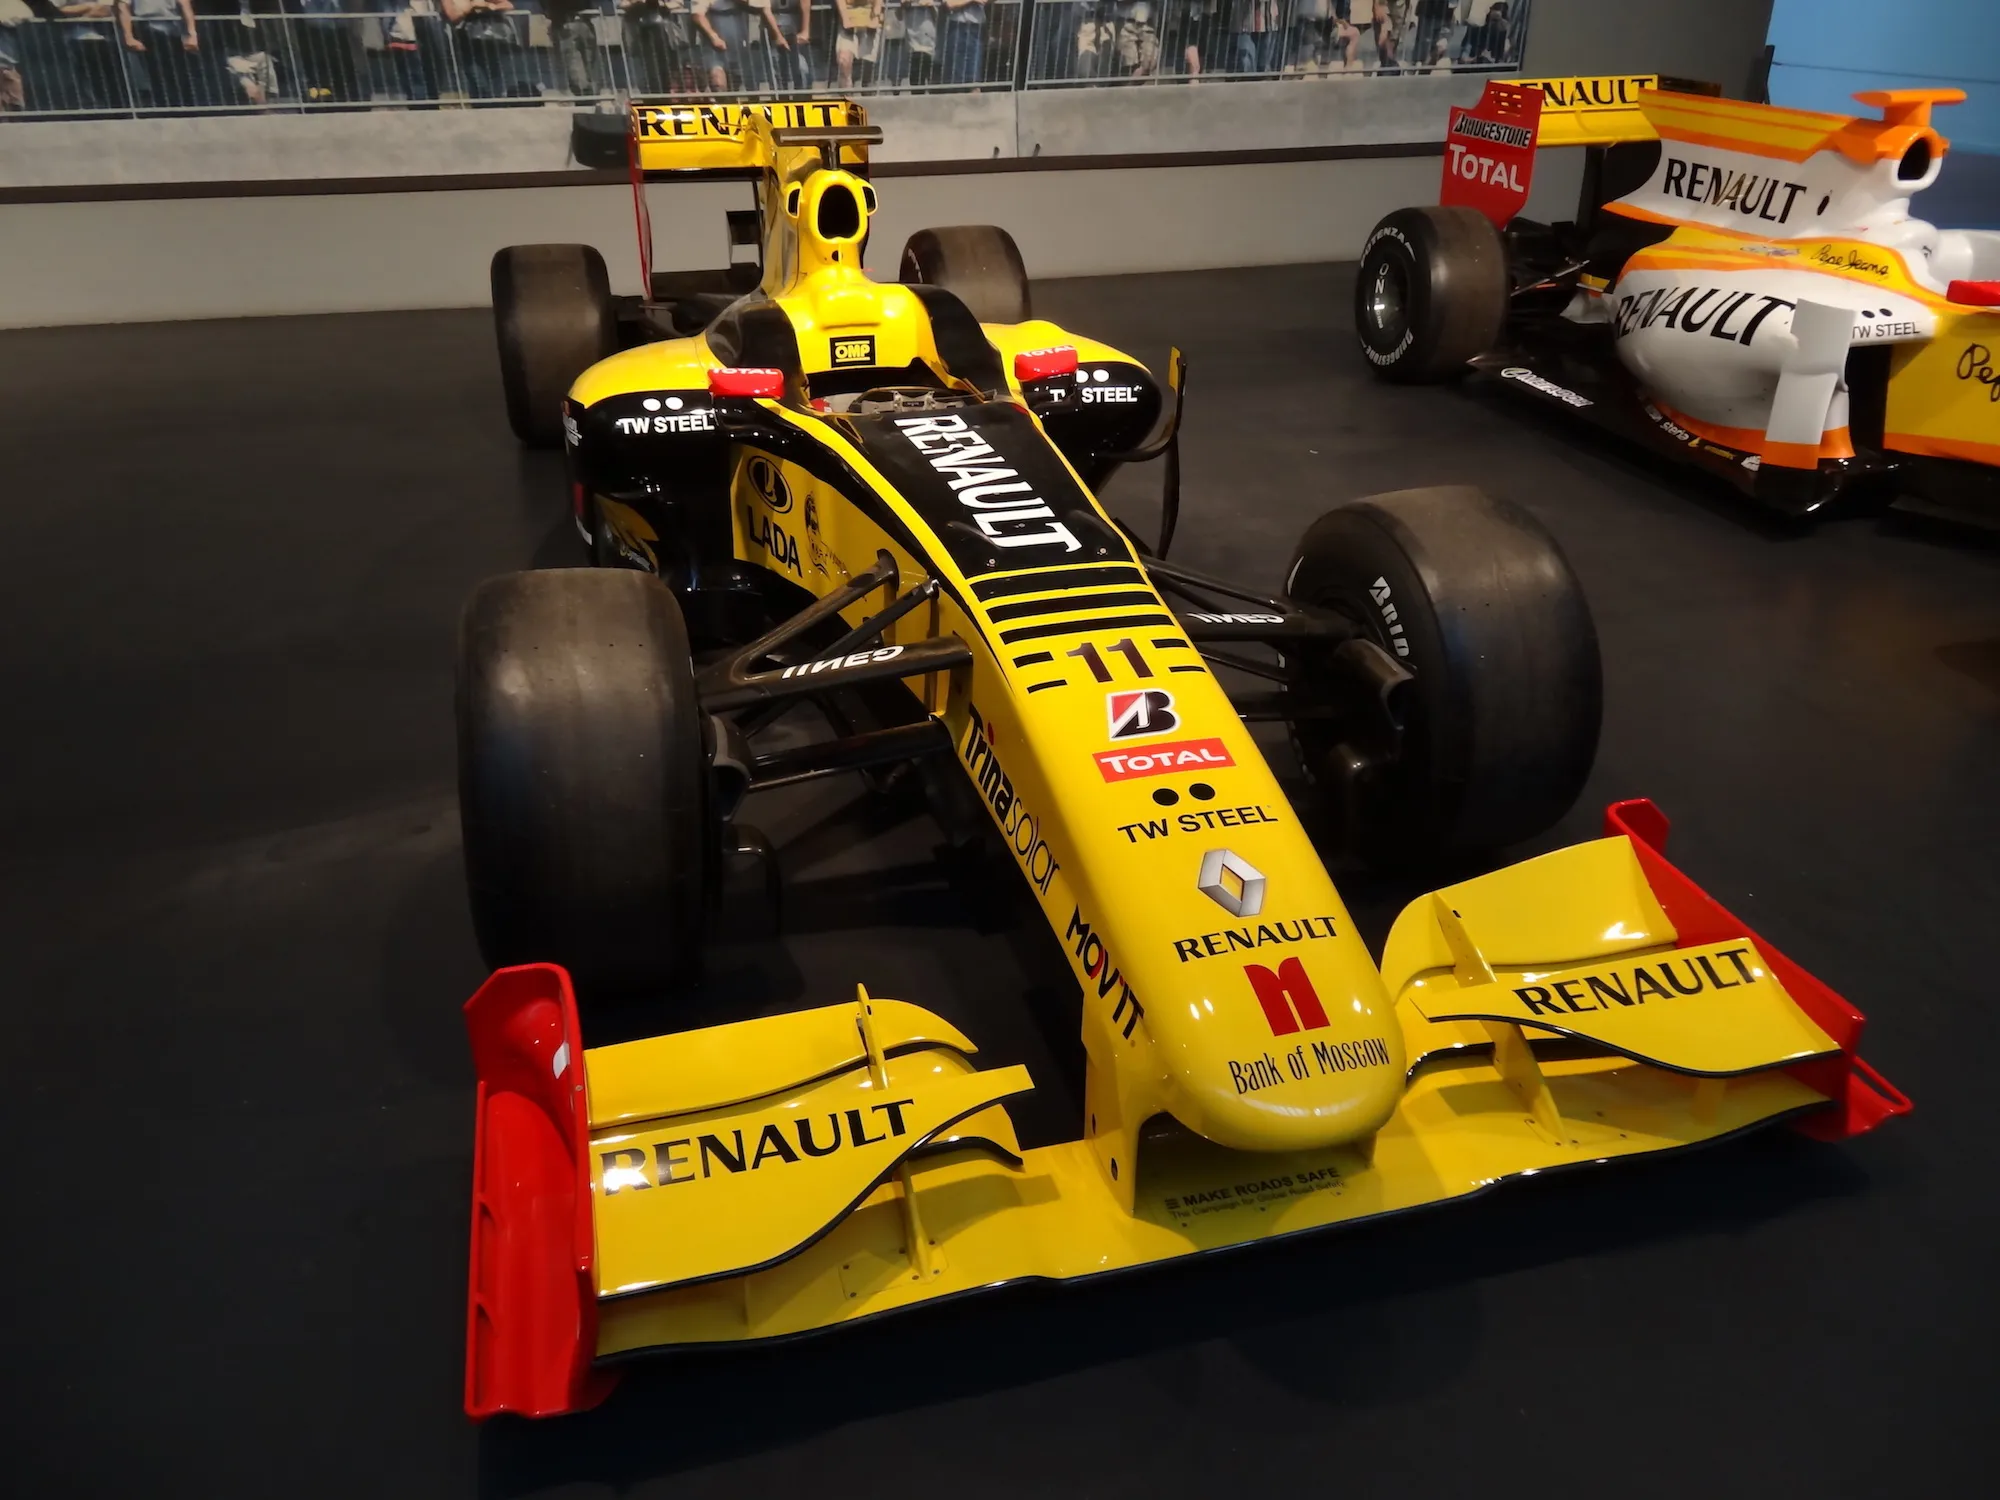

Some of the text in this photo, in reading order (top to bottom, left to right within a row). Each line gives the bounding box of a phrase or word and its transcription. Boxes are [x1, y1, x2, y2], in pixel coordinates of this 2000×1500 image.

[1452, 113, 1533, 148] BRIDGESTONE
[1449, 144, 1524, 193] TOTAL
[1663, 158, 1807, 224] RENAULT
[1811, 244, 1844, 266] Pepe
[1843, 250, 1889, 276] Jeans
[1614, 287, 1797, 347] RENAULT
[1875, 321, 1921, 338] STEEL
[711, 367, 779, 376] TOTAL
[834, 342, 871, 359] OMP
[1022, 345, 1076, 358] TOTAL
[1956, 343, 2000, 402] Pe
[1049, 386, 1138, 404] T STEEL
[619, 413, 715, 435] TW STEEL
[894, 414, 1084, 553] RENAULT
[747, 504, 803, 579] LADA
[1066, 638, 1155, 683] 11
[1100, 748, 1228, 774] TOTAL
[1117, 804, 1279, 843] TW STEEL
[1172, 916, 1338, 963] RENAULT
[1512, 948, 1757, 1016] RENAULT
[1228, 1037, 1391, 1095] Bank of Moscow
[600, 1098, 914, 1196] RENAULT
[1182, 1166, 1341, 1207] MAKE ROADS SAFE
